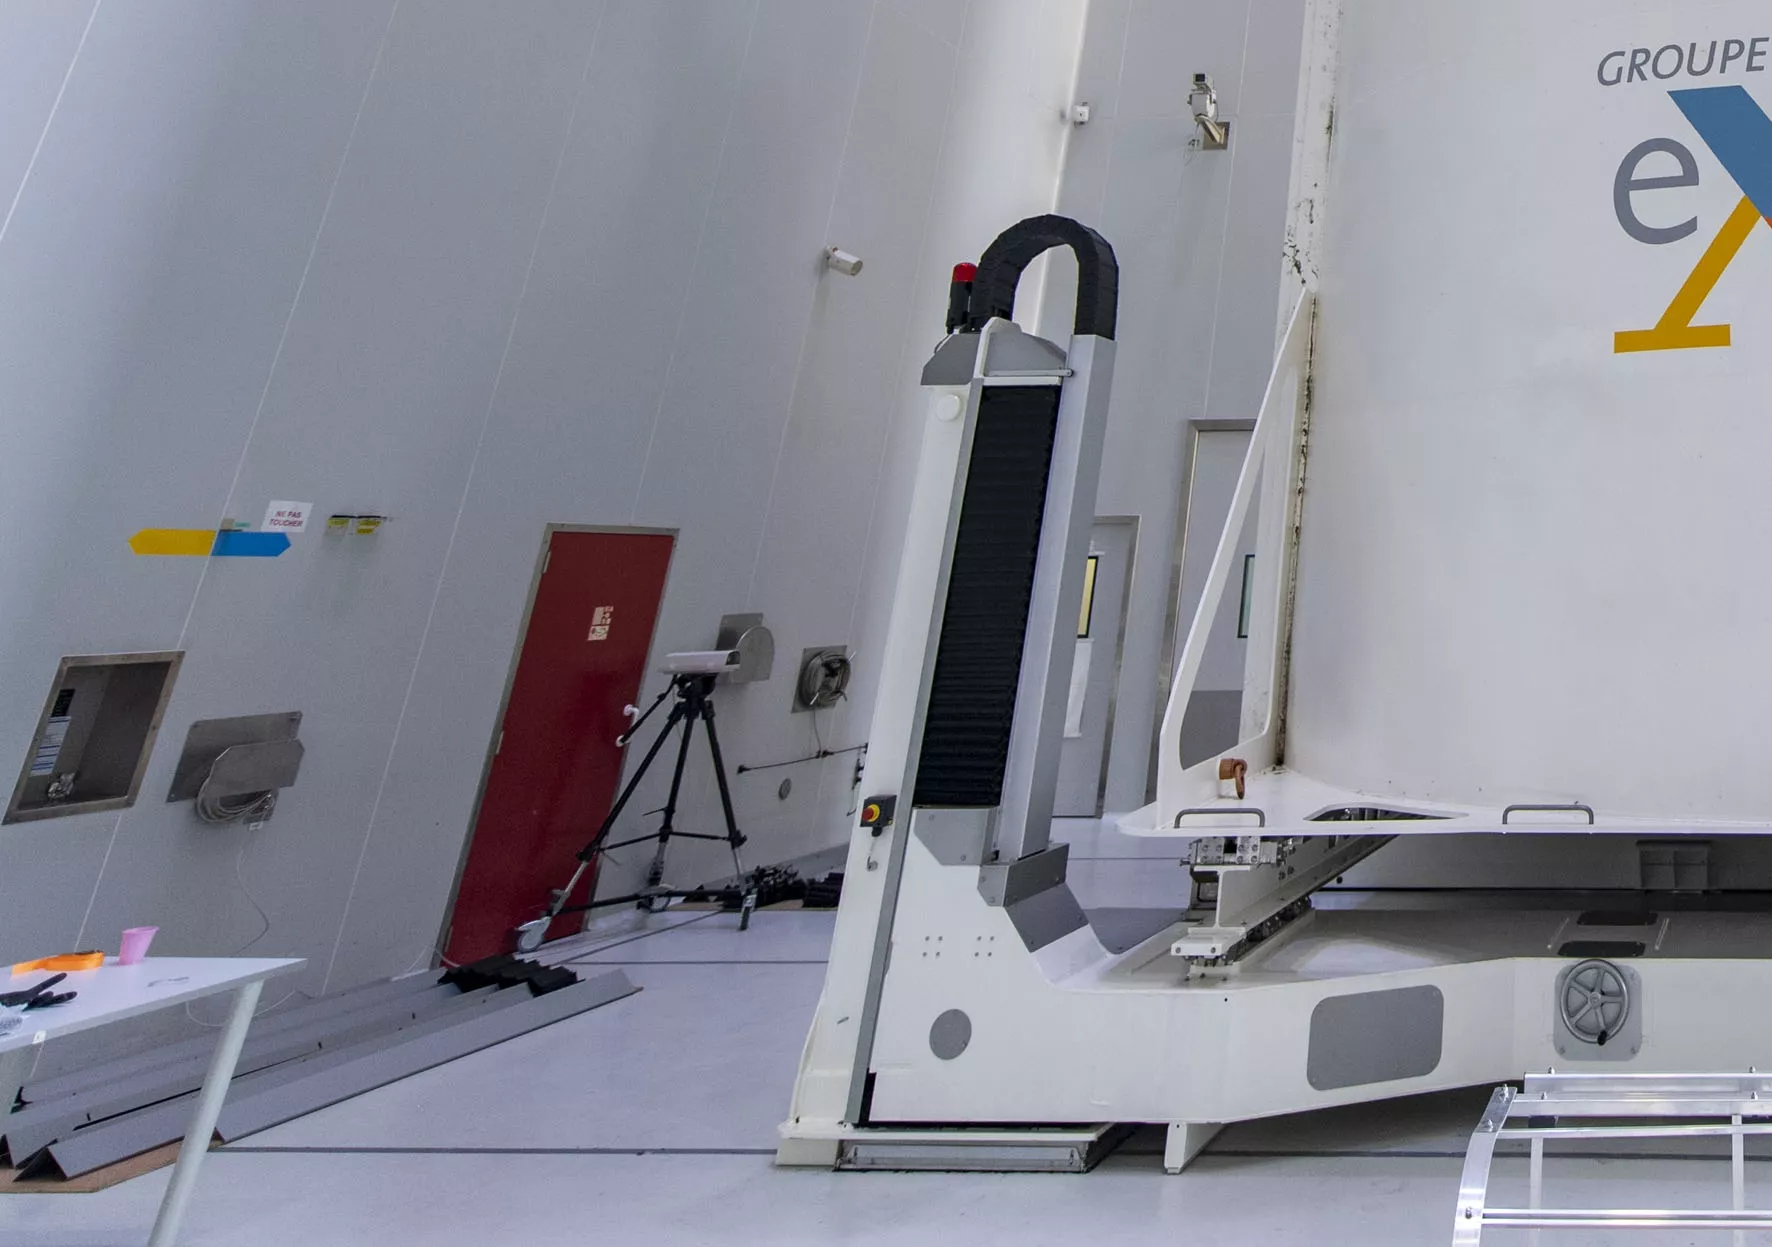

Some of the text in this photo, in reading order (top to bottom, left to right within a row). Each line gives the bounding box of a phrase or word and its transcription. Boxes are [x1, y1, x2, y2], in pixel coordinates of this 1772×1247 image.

[1597, 37, 1770, 86] GROUPE
[287, 511, 303, 519] PAS
[269, 518, 304, 527] TOUCHER
